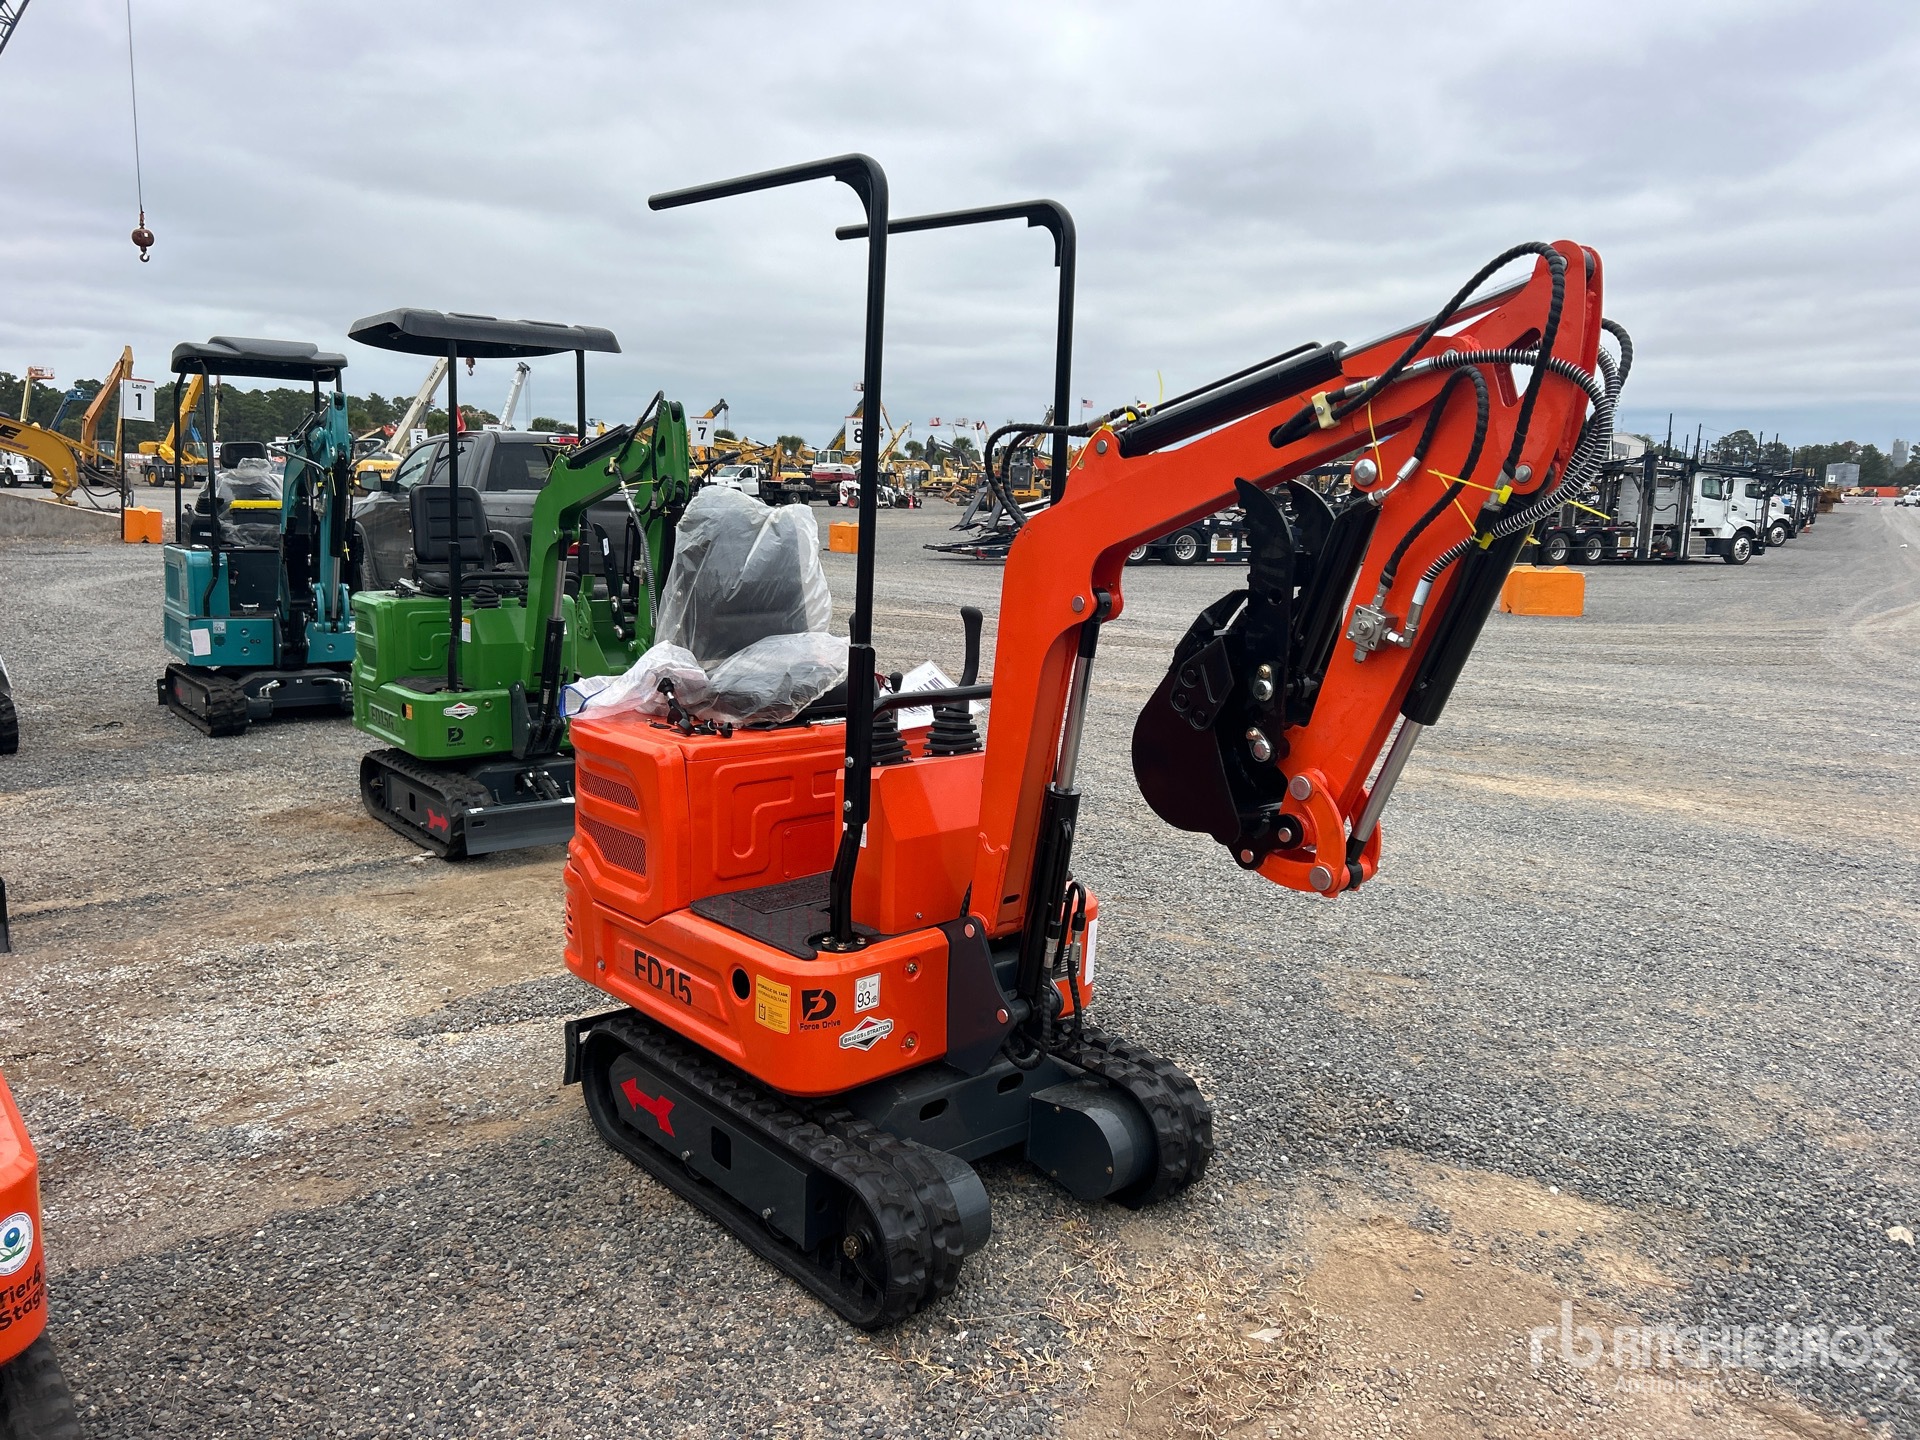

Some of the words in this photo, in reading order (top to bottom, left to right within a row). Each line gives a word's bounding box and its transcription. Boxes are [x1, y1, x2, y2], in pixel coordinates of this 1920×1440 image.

[131, 382, 147, 391] Lane
[135, 393, 142, 411] 1
[416, 435, 423, 443] 5
[697, 427, 707, 440] 7
[853, 427, 863, 443] 8
[634, 949, 692, 1006] FD15
[857, 991, 871, 1008] 93
[822, 1020, 841, 1029] Drive
[843, 1031, 864, 1044] BRIGGS
[867, 1024, 890, 1036] STRATTON
